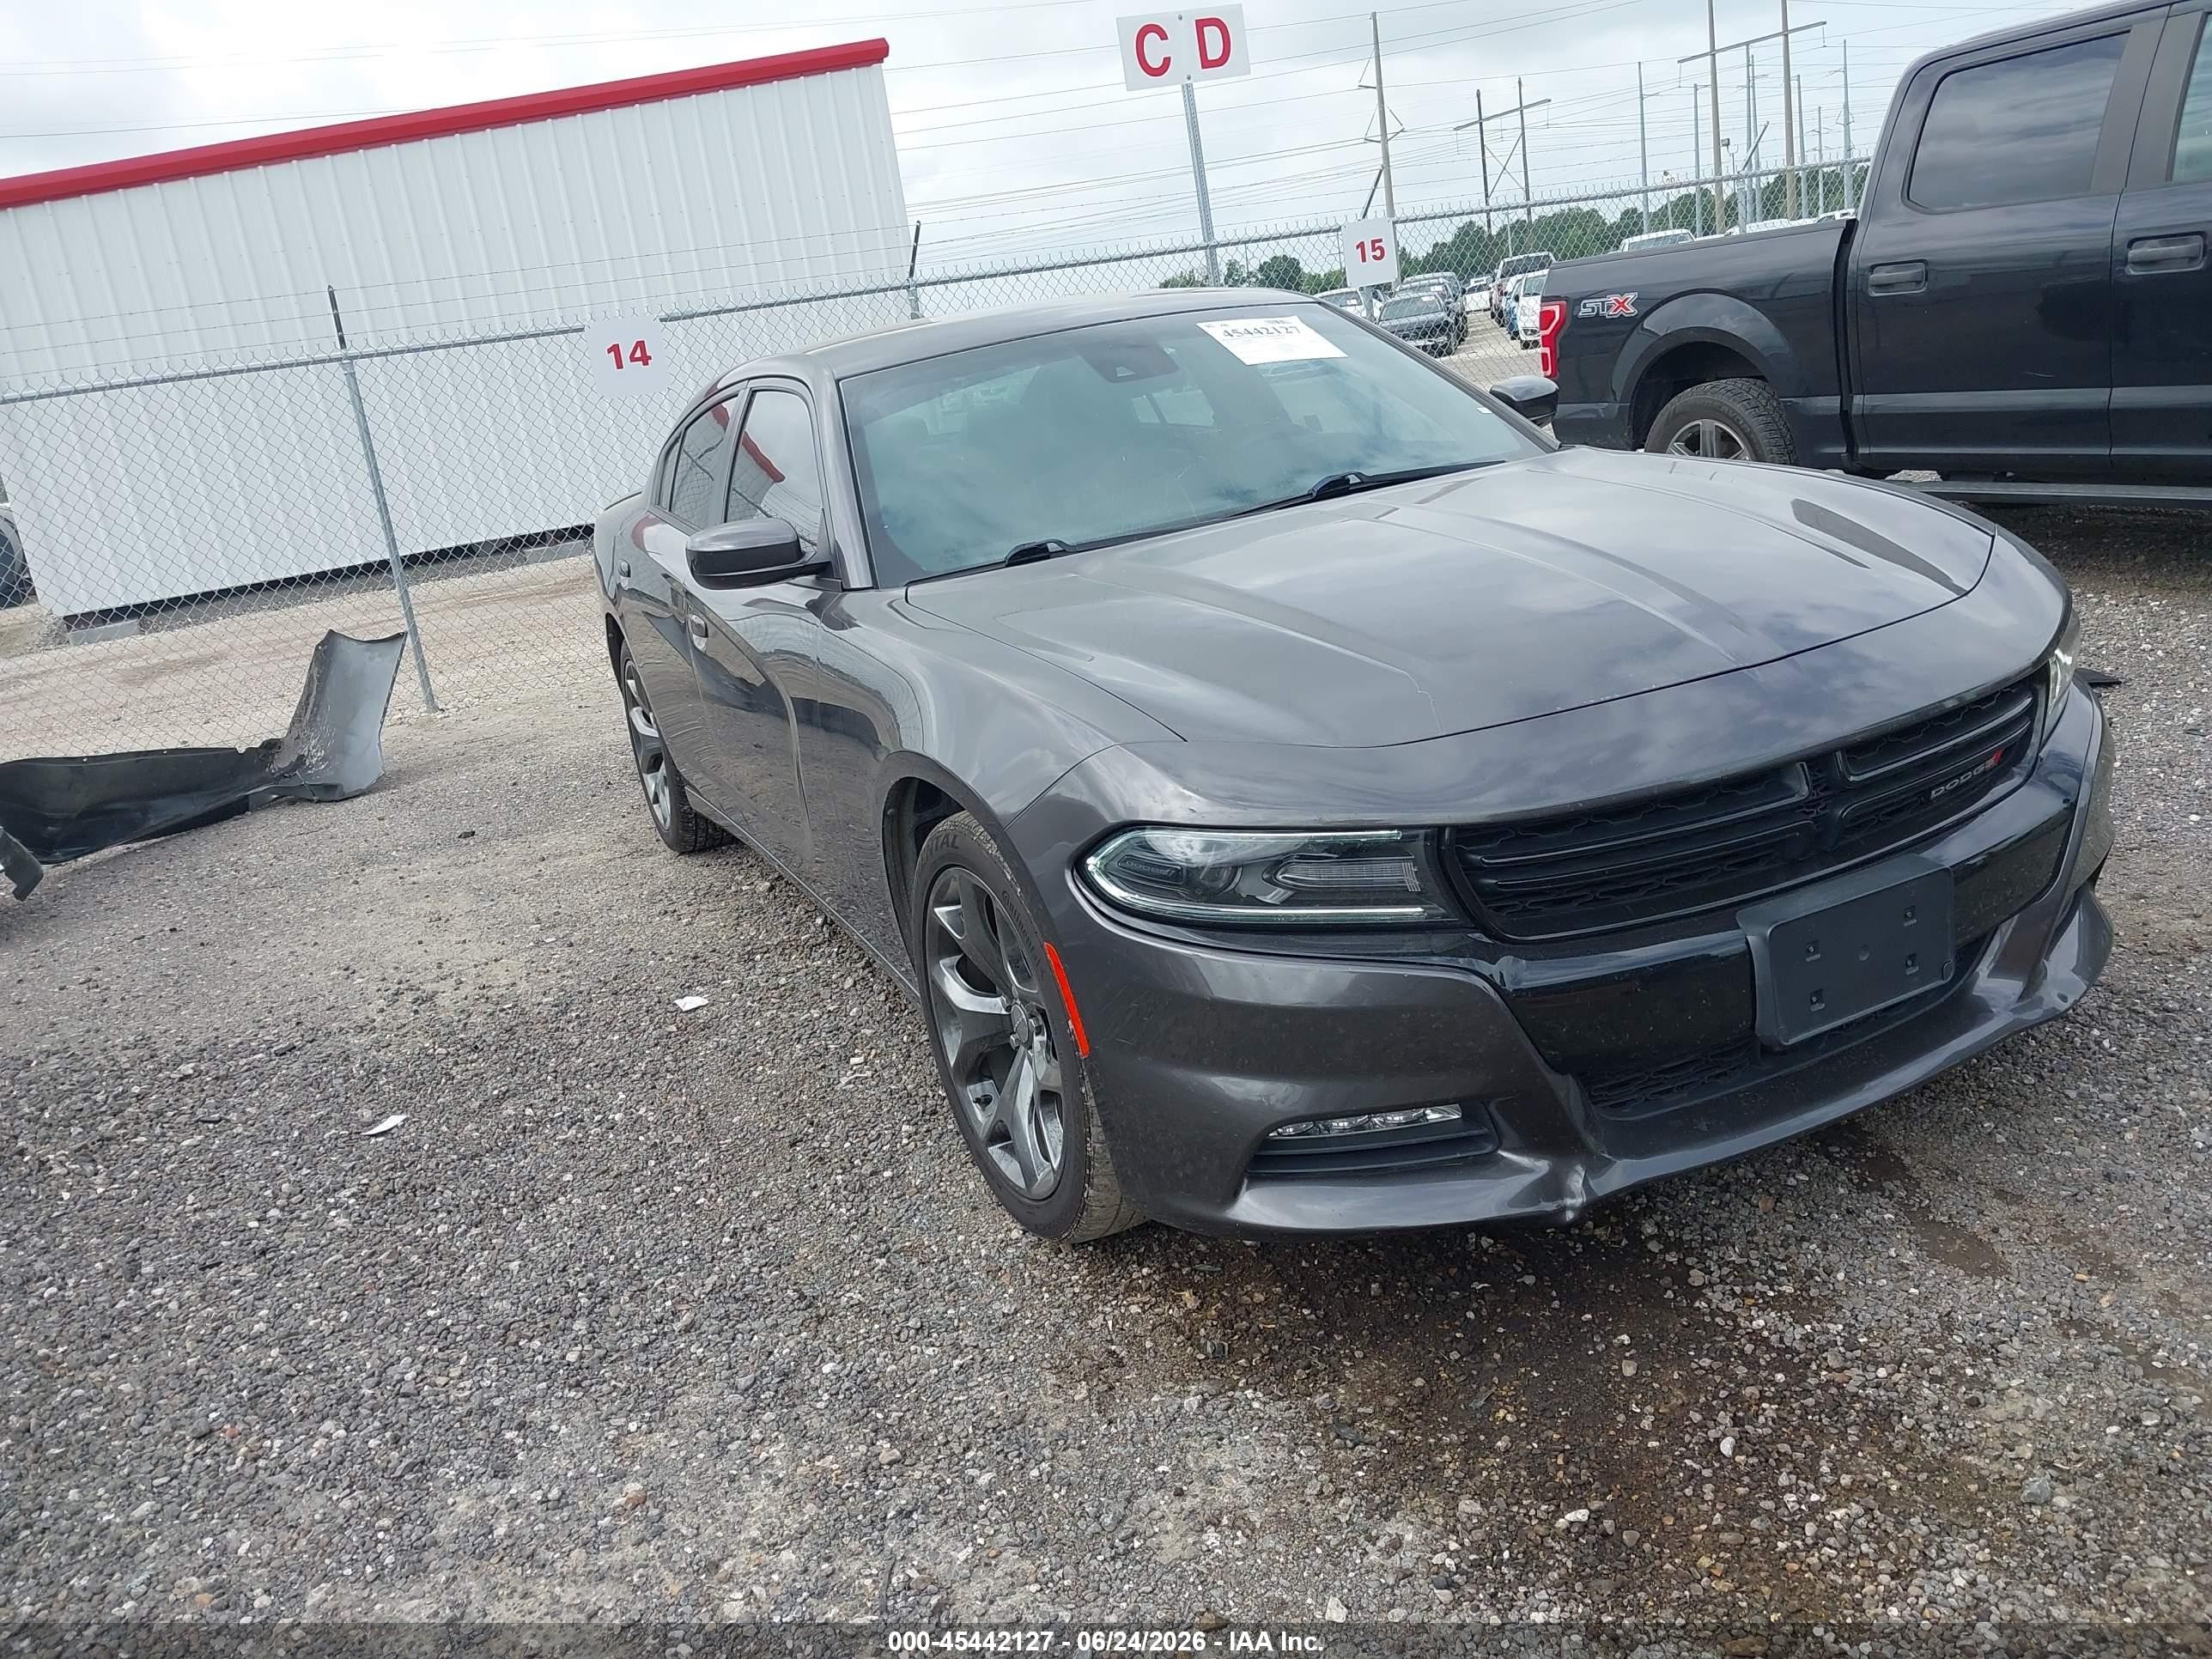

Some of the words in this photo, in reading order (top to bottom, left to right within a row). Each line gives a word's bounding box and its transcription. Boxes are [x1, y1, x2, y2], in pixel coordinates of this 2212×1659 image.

[1135, 23, 1171, 77] C
[1194, 16, 1231, 70] D
[1355, 238, 1386, 264] 15
[1577, 292, 1638, 319] STX
[1223, 325, 1301, 337] 45442127
[606, 339, 653, 370] 14
[1930, 755, 1995, 799] DODGE
